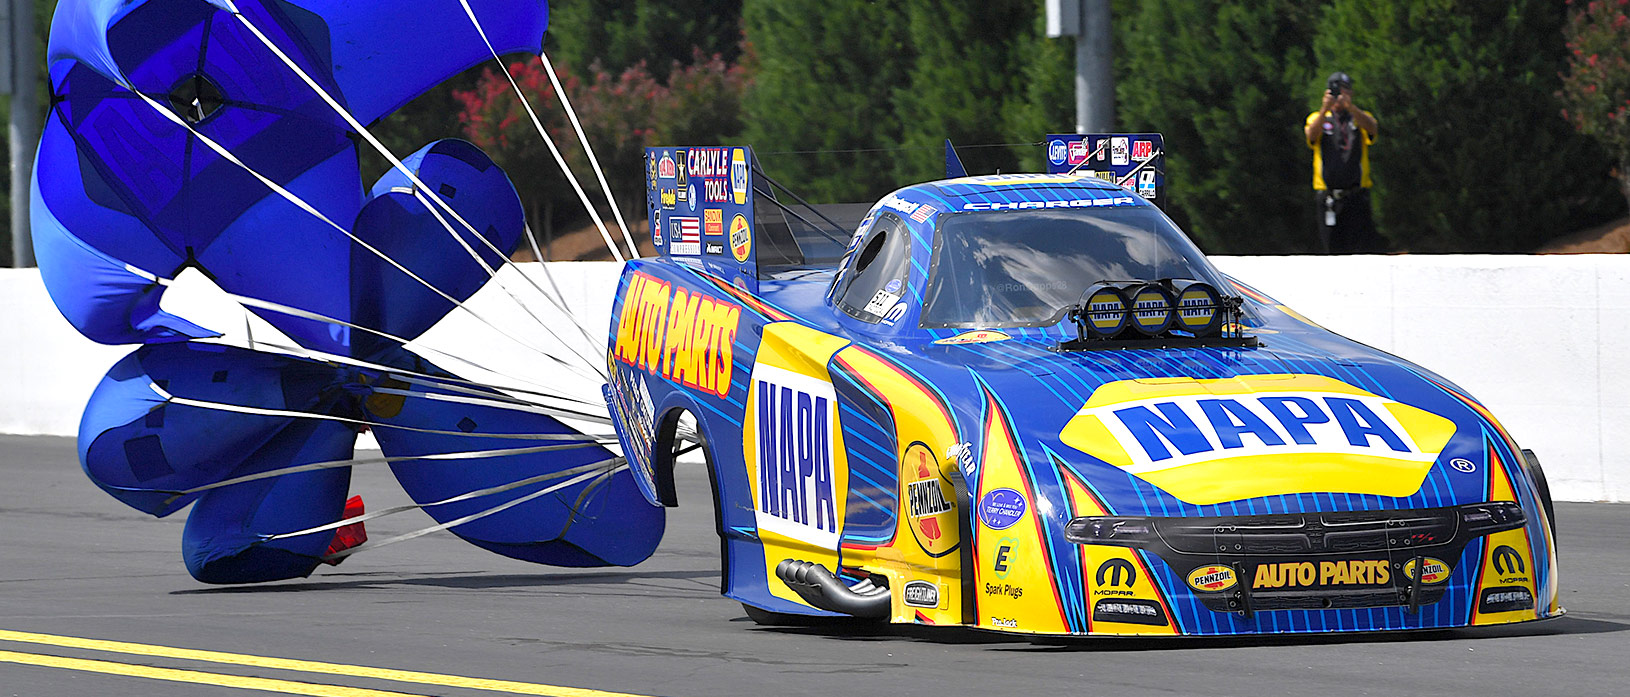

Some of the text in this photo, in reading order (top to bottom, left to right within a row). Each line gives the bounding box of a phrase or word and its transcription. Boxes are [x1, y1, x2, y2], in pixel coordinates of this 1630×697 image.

[1132, 141, 1152, 157] ARP
[687, 148, 728, 177] CARLYLE
[704, 179, 728, 203] TOOLS
[963, 197, 1134, 211] CHARGER
[671, 222, 682, 239] USA
[996, 281, 1067, 292] @Ronpps28
[1092, 302, 1120, 319] NAPA
[1138, 301, 1165, 317] NAPA
[1183, 299, 1211, 316] NAPA
[614, 270, 672, 376] AUTO
[661, 286, 742, 400] PARTS
[1112, 396, 1412, 463] NAPA
[758, 380, 835, 534] NAPA
[907, 478, 952, 519] PENNZOIL
[1194, 571, 1233, 586] PENNZOIL
[1252, 559, 1390, 589] AUTO PARTS
[1410, 564, 1444, 577] PNZOIL
[985, 582, 1022, 600] Spark Plugs
